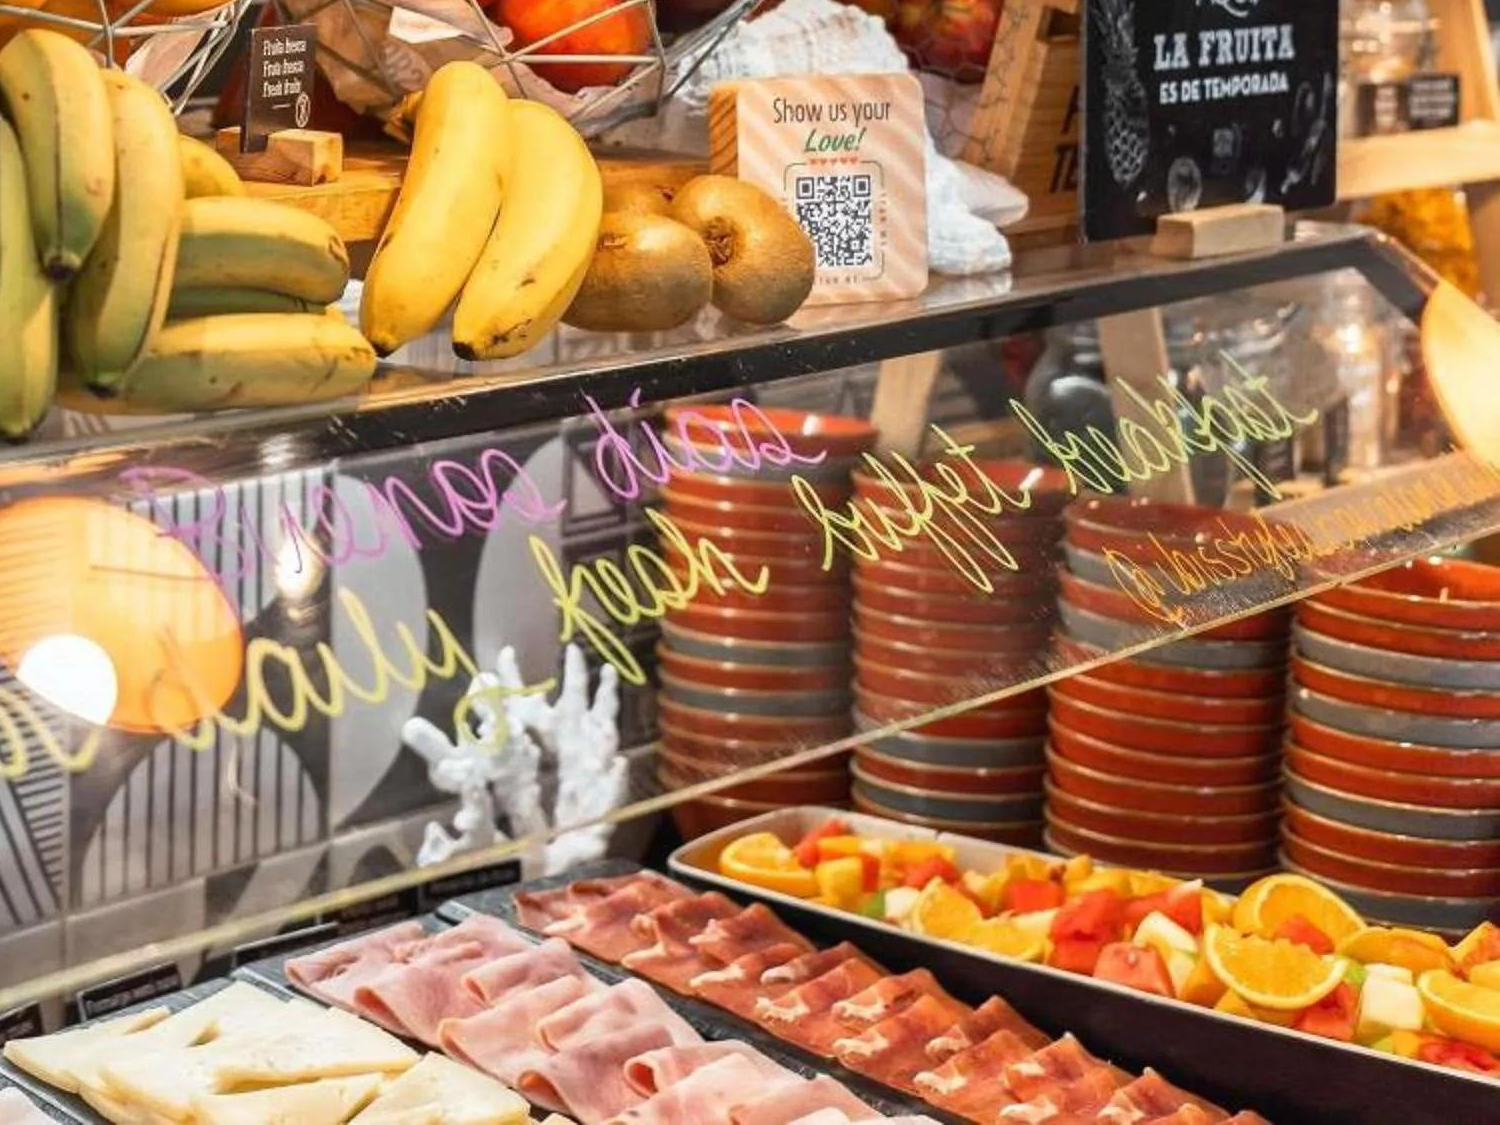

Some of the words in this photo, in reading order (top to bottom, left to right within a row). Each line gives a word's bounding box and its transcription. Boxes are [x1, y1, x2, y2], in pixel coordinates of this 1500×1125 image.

[1153, 32, 1190, 71] LA
[1198, 24, 1296, 67] FRUITA
[1159, 80, 1178, 104] ES
[1181, 78, 1200, 102] DE
[1204, 71, 1289, 100] TEMPORADA
[773, 98, 823, 123] Show
[829, 103, 847, 122] us
[852, 101, 890, 127] your
[804, 127, 867, 152] Love!
[528, 507, 769, 686] fresh
[791, 424, 1030, 592] buffet
[1009, 350, 1319, 500] breakfast
